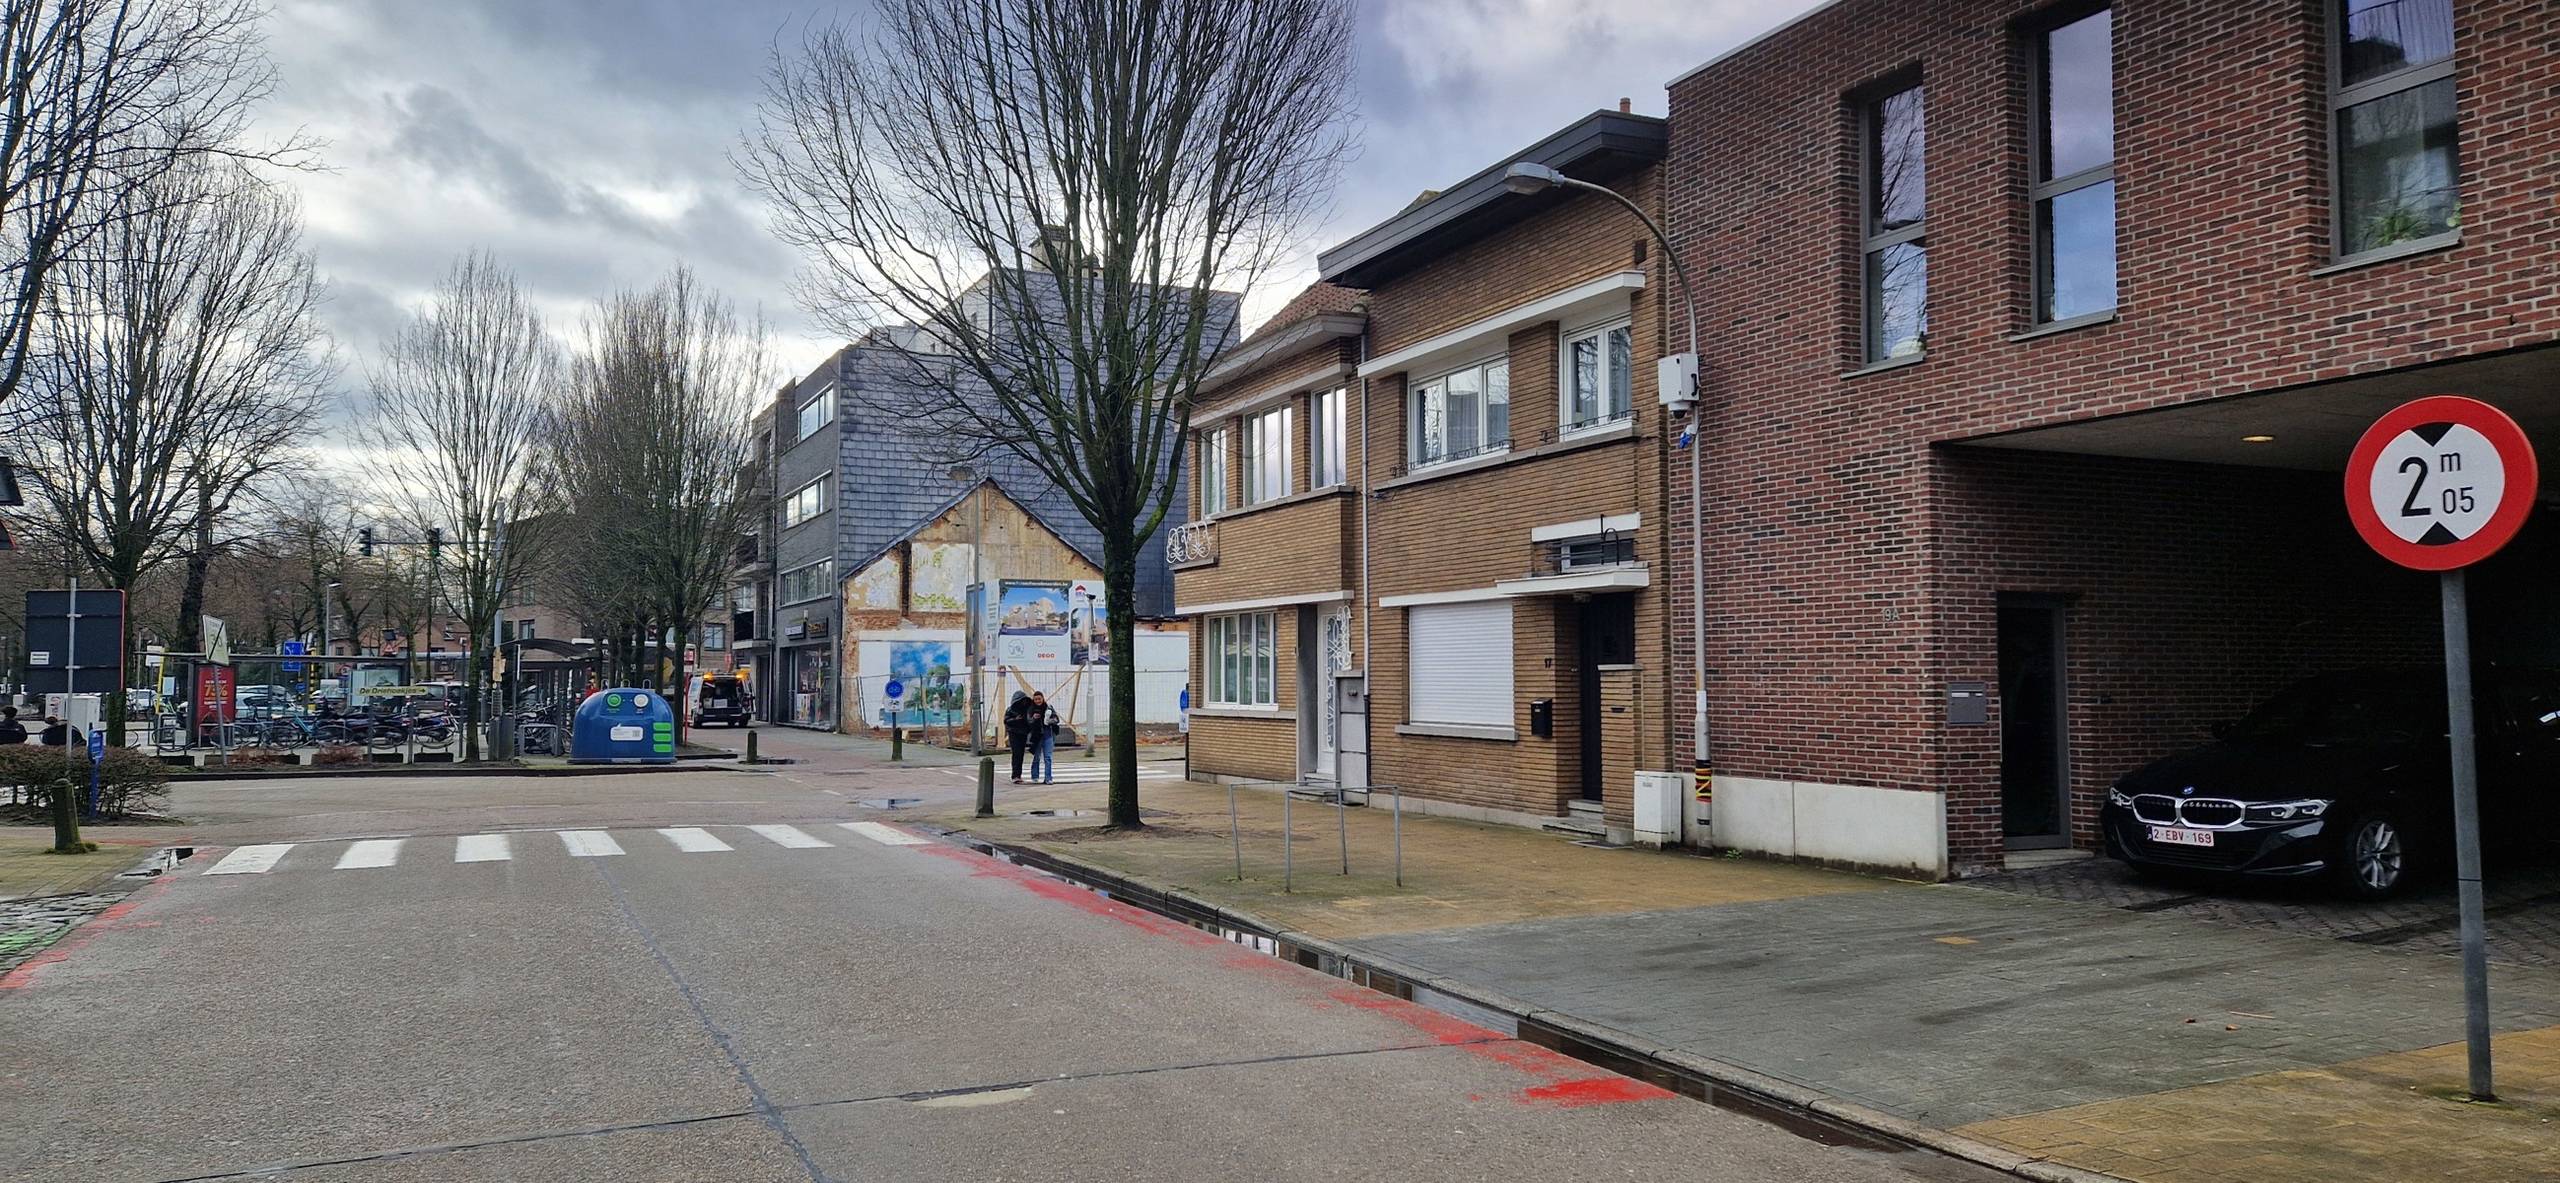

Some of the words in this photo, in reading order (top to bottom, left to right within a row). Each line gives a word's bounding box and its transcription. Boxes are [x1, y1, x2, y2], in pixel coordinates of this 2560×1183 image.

[2398, 456, 2432, 518] 2
[2440, 452, 2462, 473] m
[2442, 486, 2475, 515] 05
